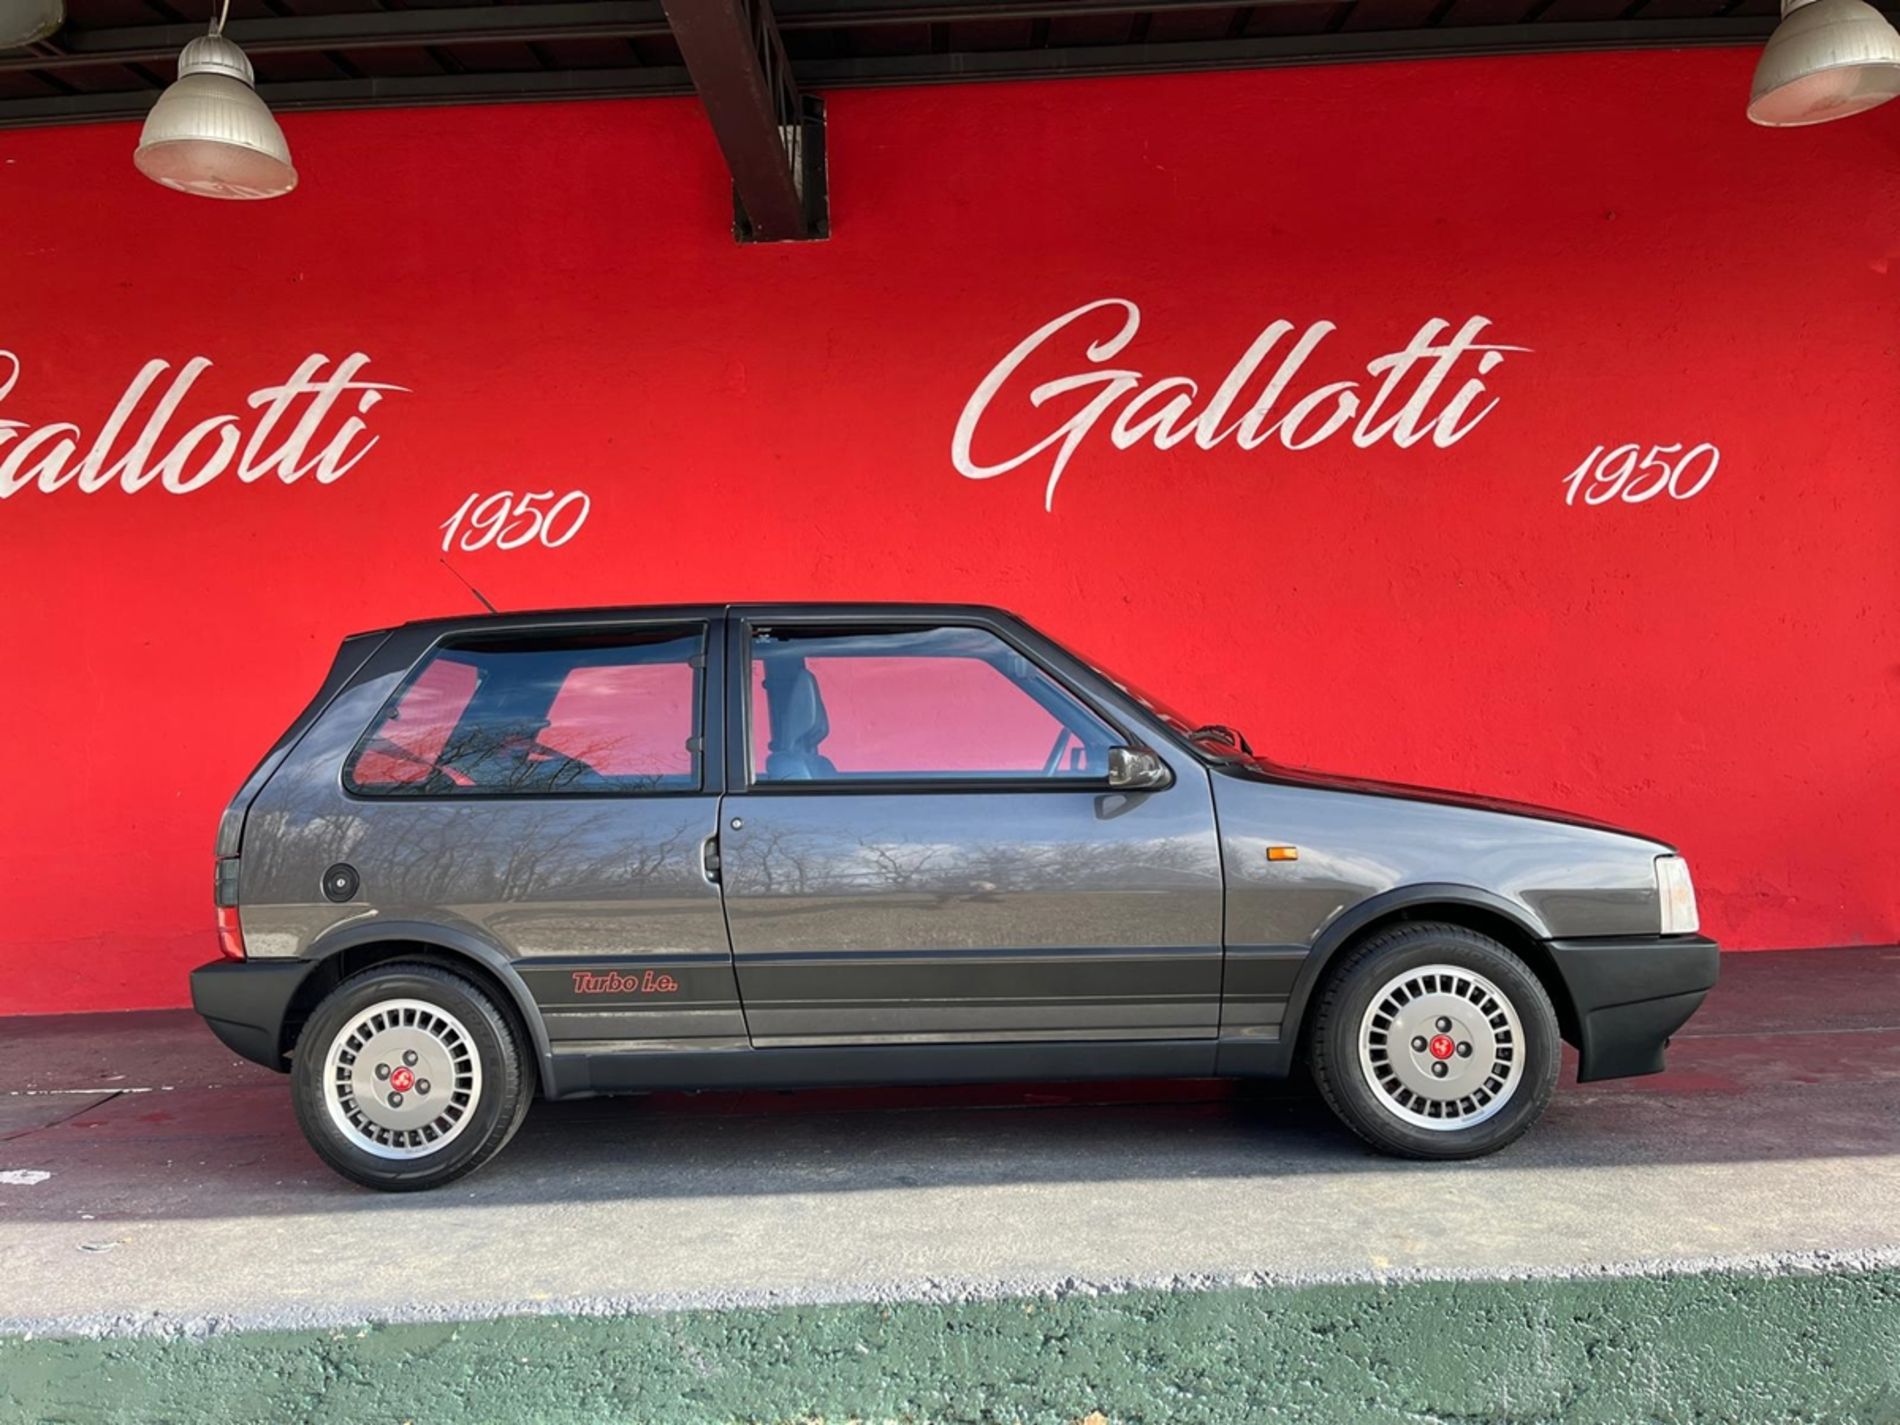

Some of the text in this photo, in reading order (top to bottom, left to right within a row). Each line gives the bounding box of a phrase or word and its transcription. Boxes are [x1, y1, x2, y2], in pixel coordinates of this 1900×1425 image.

[0, 349, 413, 499] allotti
[951, 298, 1533, 513] Gallotti
[1562, 442, 1721, 506] 1950
[439, 489, 591, 552] 1950
[572, 970, 679, 994] Turbo i.e.
